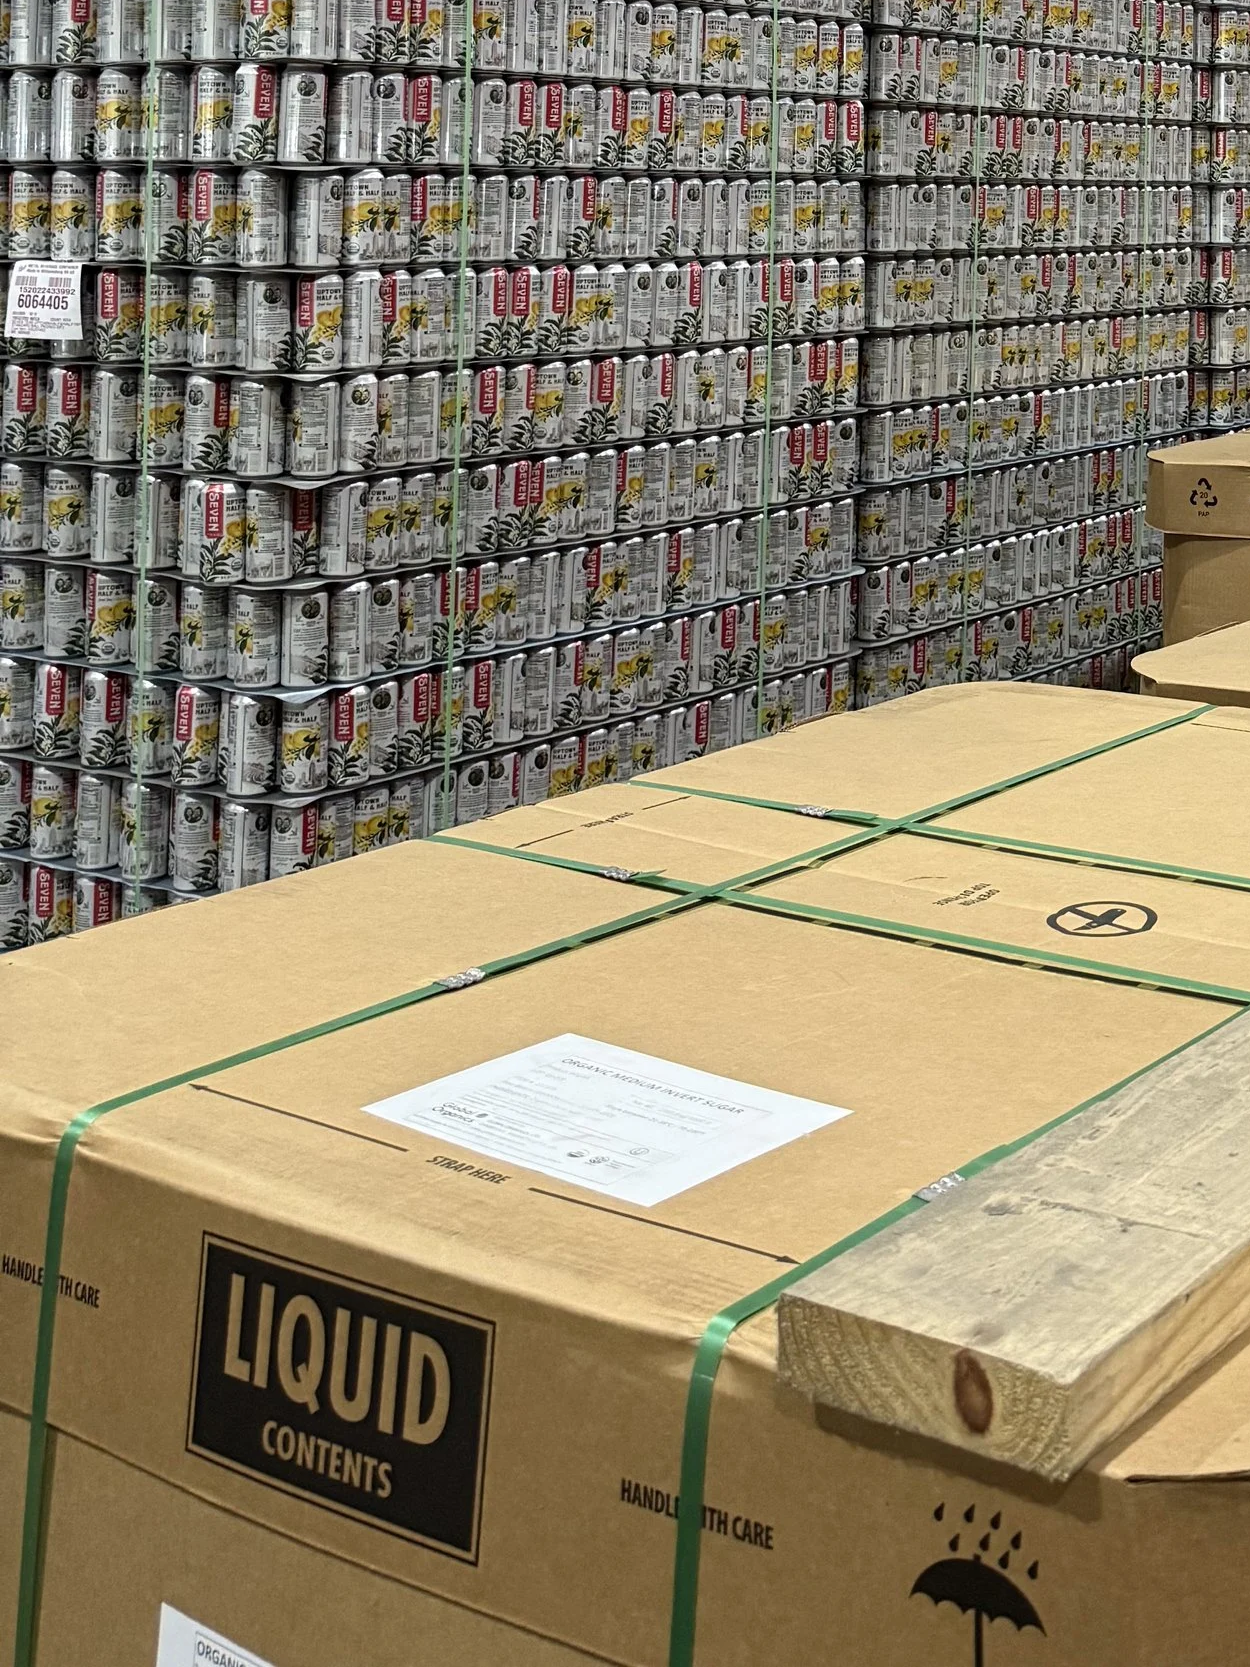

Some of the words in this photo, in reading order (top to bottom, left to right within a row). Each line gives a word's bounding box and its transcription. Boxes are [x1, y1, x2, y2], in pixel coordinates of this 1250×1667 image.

[259, 70, 272, 112] SEVEN
[550, 85, 560, 122] SEVEN
[662, 91, 672, 128] SEVEN
[850, 104, 858, 136] SEVEN
[198, 173, 208, 214] SEVEN
[104, 273, 114, 312] SEVEN
[497, 271, 506, 310] SEVEN
[516, 271, 527, 310] SEVEN
[784, 260, 792, 296] SEVEN
[18, 294, 68, 310] 6064405
[299, 283, 310, 320] SEVEN
[21, 371, 32, 406] SEVEN
[66, 375, 78, 408] SEVEN
[483, 368, 495, 408] SEVEN
[601, 359, 612, 396] SEVEN
[664, 358, 672, 390] SEVEN
[208, 491, 220, 532] SEVEN
[725, 609, 734, 642] SEVEN
[49, 672, 62, 708] SEVEN
[110, 679, 122, 716] SEVEN
[478, 663, 488, 702] SEVEN
[179, 692, 190, 734] SEVEN
[338, 694, 350, 738] SEVEN
[699, 704, 707, 738] SEVEN
[305, 809, 316, 848] SEVEN
[561, 1058, 613, 1076] ORGANIC
[611, 1073, 662, 1091] MEDIUM
[661, 1087, 703, 1103] INVERT
[701, 1099, 745, 1115] SUGAR
[432, 1106, 474, 1124] Organics
[442, 1102, 477, 1118] Global
[426, 1155, 474, 1176] STRAP
[471, 1165, 512, 1185] HERE
[75, 1281, 100, 1309] CARE
[224, 1273, 451, 1445] LIQUID
[261, 1419, 393, 1498] CONTENTS
[701, 1504, 728, 1536] ITH
[732, 1515, 774, 1551] CARE
